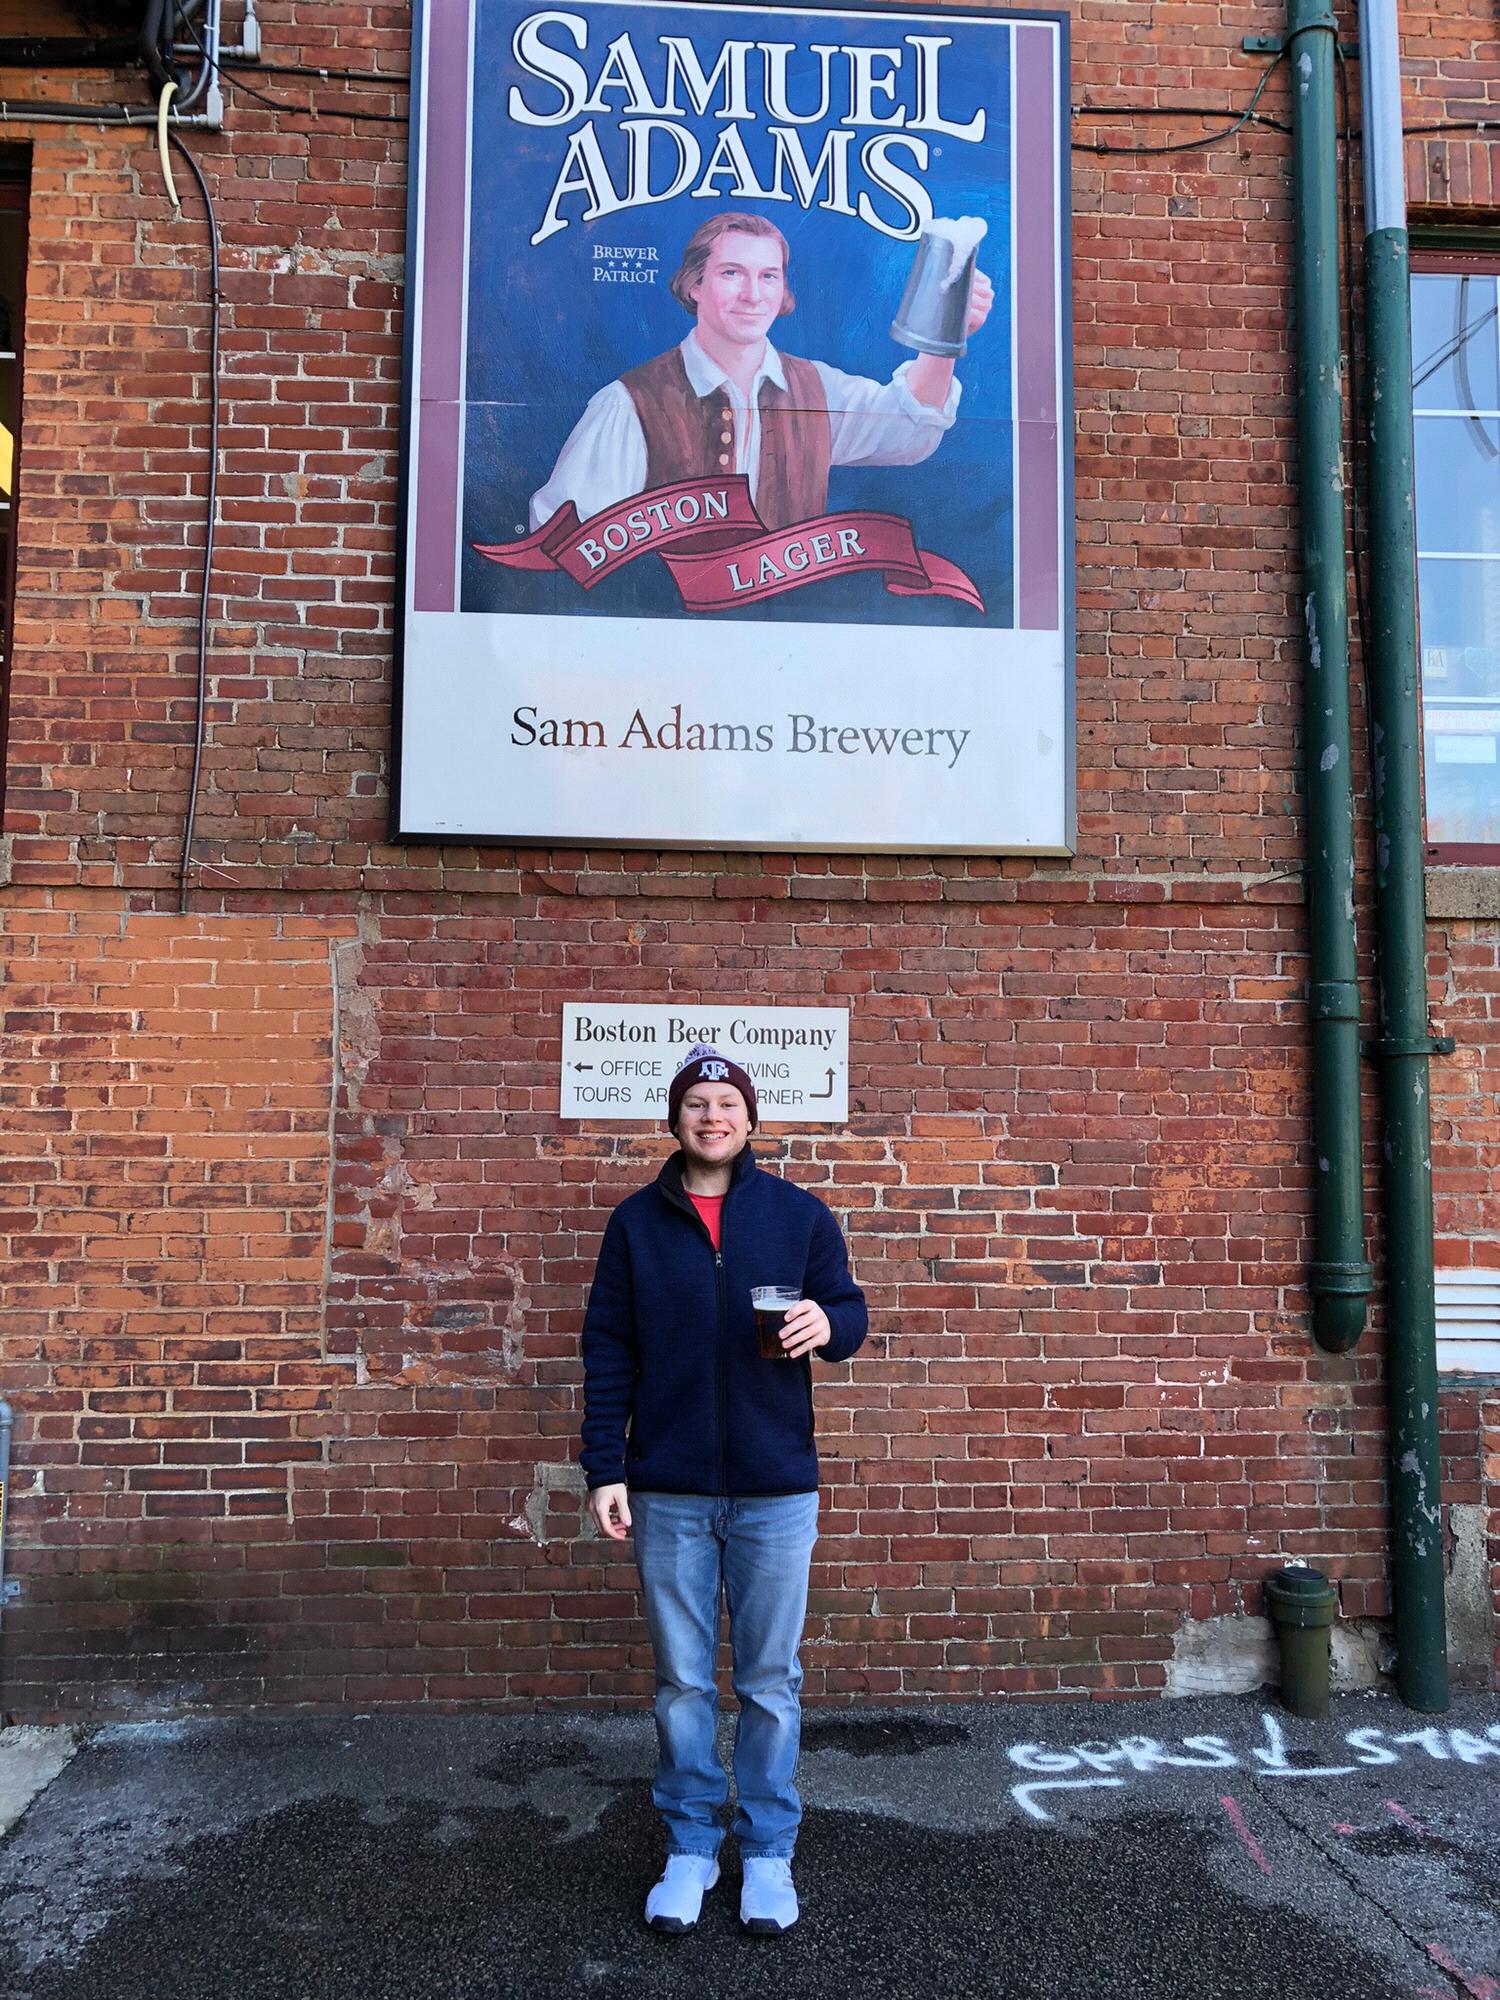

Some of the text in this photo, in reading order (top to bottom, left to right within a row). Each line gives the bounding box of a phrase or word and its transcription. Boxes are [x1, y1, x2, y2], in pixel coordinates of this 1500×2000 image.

[508, 10, 987, 143] SAMUEL
[530, 119, 934, 246] ADAMS
[592, 244, 659, 261] BREWER
[592, 266, 659, 284] PATRIOT
[576, 490, 730, 570] BOSTON
[726, 527, 868, 593] LAGER
[510, 704, 971, 768] Sam Adams Brewery
[574, 1016, 837, 1051] Boston Beer Company
[600, 1060, 663, 1077] OFFICE
[573, 1086, 632, 1103] TOURS
[756, 1088, 804, 1105] RNER
